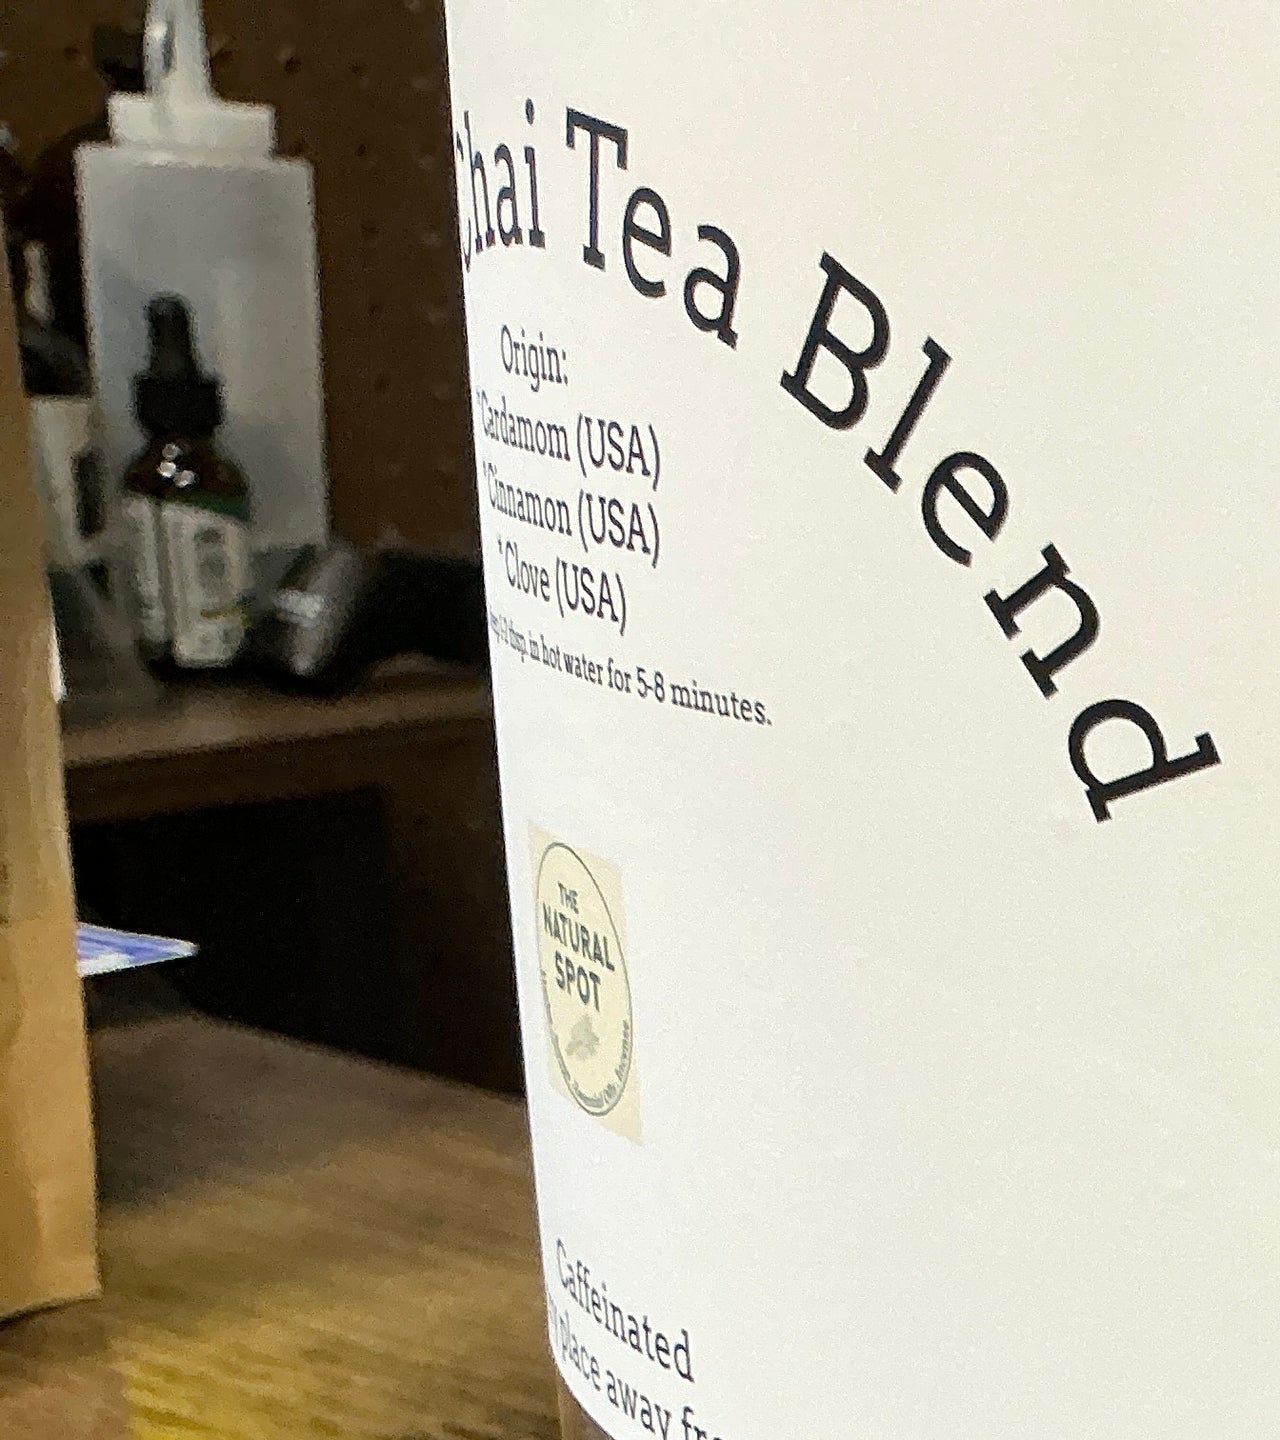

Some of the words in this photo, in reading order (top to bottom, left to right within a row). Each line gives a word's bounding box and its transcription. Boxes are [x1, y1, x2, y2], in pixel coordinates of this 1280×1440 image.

[500, 323, 568, 392] Origin:
[566, 106, 738, 349] Tea
[780, 251, 1223, 822] Blend
[577, 412, 660, 491] (USA)
[578, 488, 660, 569] (USA)
[556, 556, 627, 637] (USA)
[540, 633, 562, 672] hot
[562, 652, 603, 686] water
[608, 656, 633, 695] for
[636, 665, 665, 704] 5-8
[670, 679, 773, 728] minutes.
[542, 902, 616, 972] NATURAL
[557, 880, 580, 915] THE
[554, 950, 601, 1013] SPOT
[556, 1237, 695, 1383] Caffeinated
[559, 1310, 601, 1392] place
